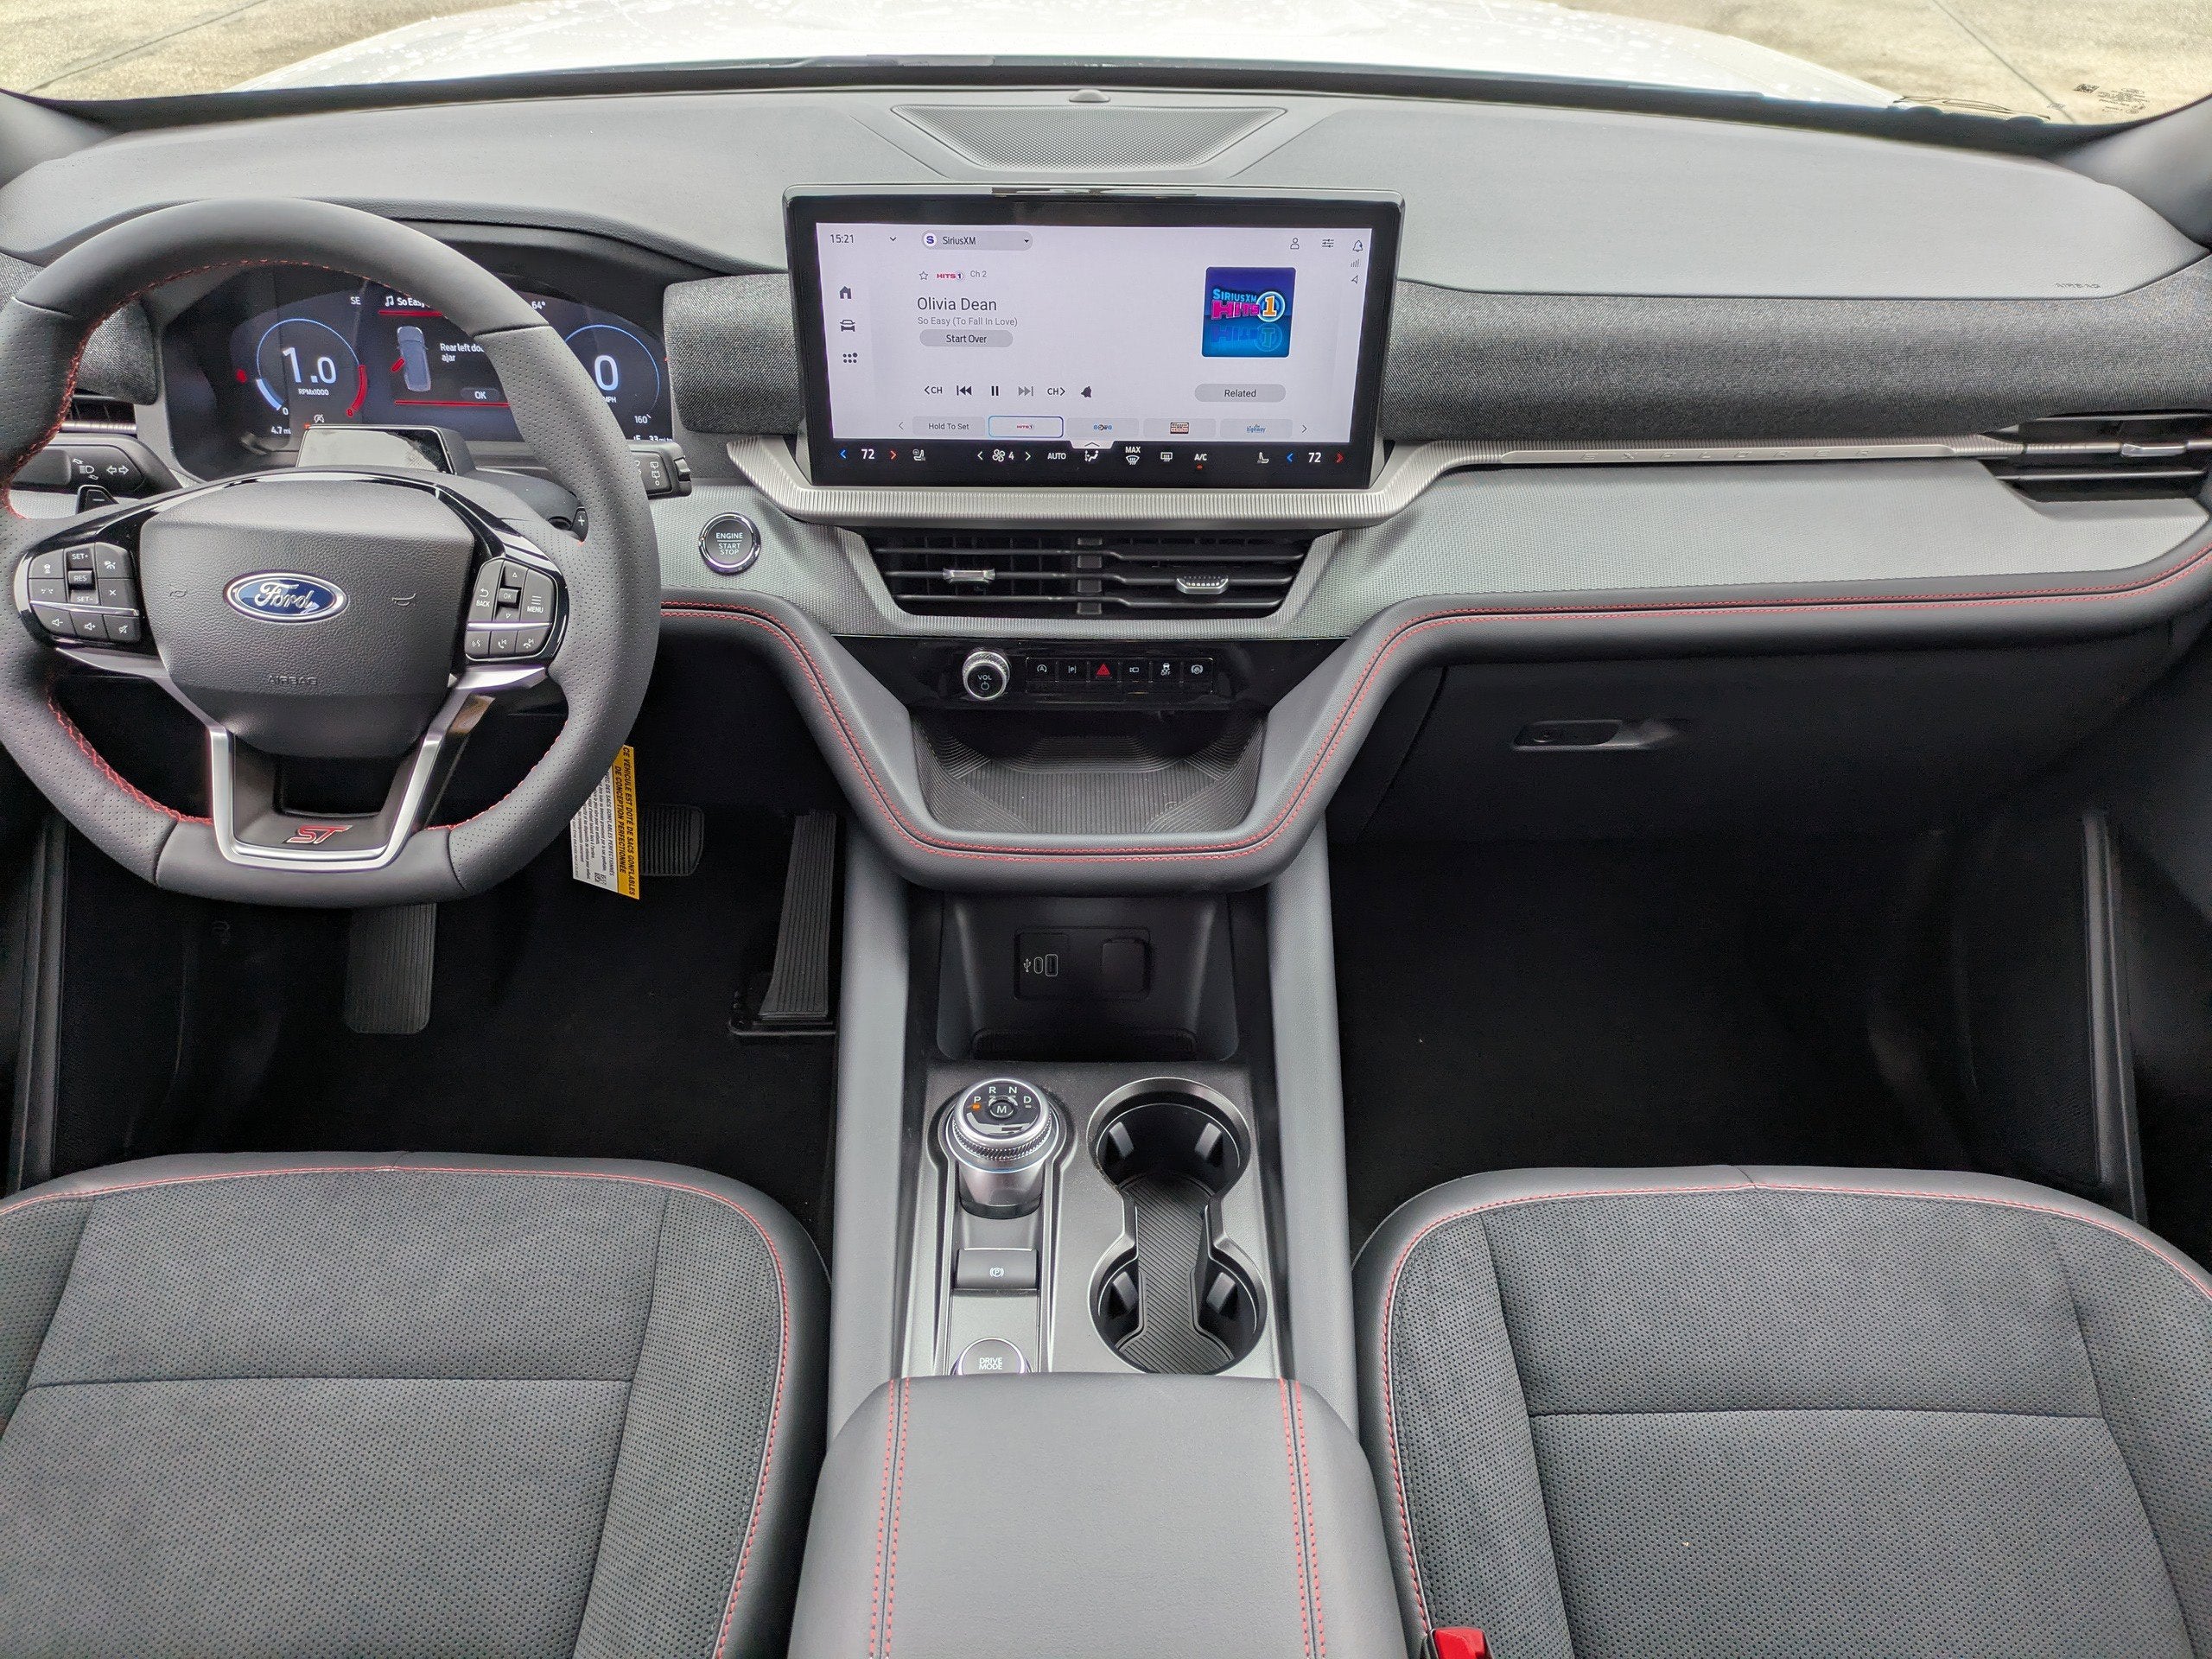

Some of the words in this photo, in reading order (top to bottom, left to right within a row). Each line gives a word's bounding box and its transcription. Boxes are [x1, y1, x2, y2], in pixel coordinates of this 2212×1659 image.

[830, 234, 855, 244] 15:21
[942, 236, 976, 245] SiriusXM
[969, 270, 981, 278] Ch
[982, 270, 987, 278] 2
[397, 297, 407, 306] So
[917, 297, 957, 311] Olivia
[961, 298, 997, 311] Dean
[1262, 296, 1278, 318] 1
[917, 317, 929, 325] So
[931, 317, 950, 327] Easy
[953, 317, 967, 327] (To
[969, 317, 983, 326] Fall
[985, 317, 993, 326] In
[995, 317, 1018, 327] Love)
[946, 334, 966, 344] Start
[967, 334, 987, 344] Over
[440, 343, 456, 352] Rear
[457, 343, 471, 352] left
[472, 343, 485, 353] do
[442, 355, 456, 363] ajar
[282, 347, 337, 384] 1.0
[594, 355, 618, 391] 0
[931, 386, 943, 394] CH
[1047, 388, 1059, 396] CH
[1224, 389, 1257, 397] Related
[475, 391, 486, 400] OK
[634, 416, 648, 424] 160
[271, 426, 283, 434] 4.7
[861, 448, 875, 460] 72
[1008, 451, 1015, 460] 4
[1047, 451, 1067, 460] AUTO
[1194, 453, 1208, 461] A/C
[1308, 452, 1322, 463] 72
[254, 582, 317, 610] Ford
[267, 676, 318, 686] AIRBAG
[615, 766, 622, 776] DE
[623, 747, 630, 757] CE
[627, 826, 633, 835] DE
[616, 777, 624, 820] CONCEPTION
[286, 823, 353, 845] ST
